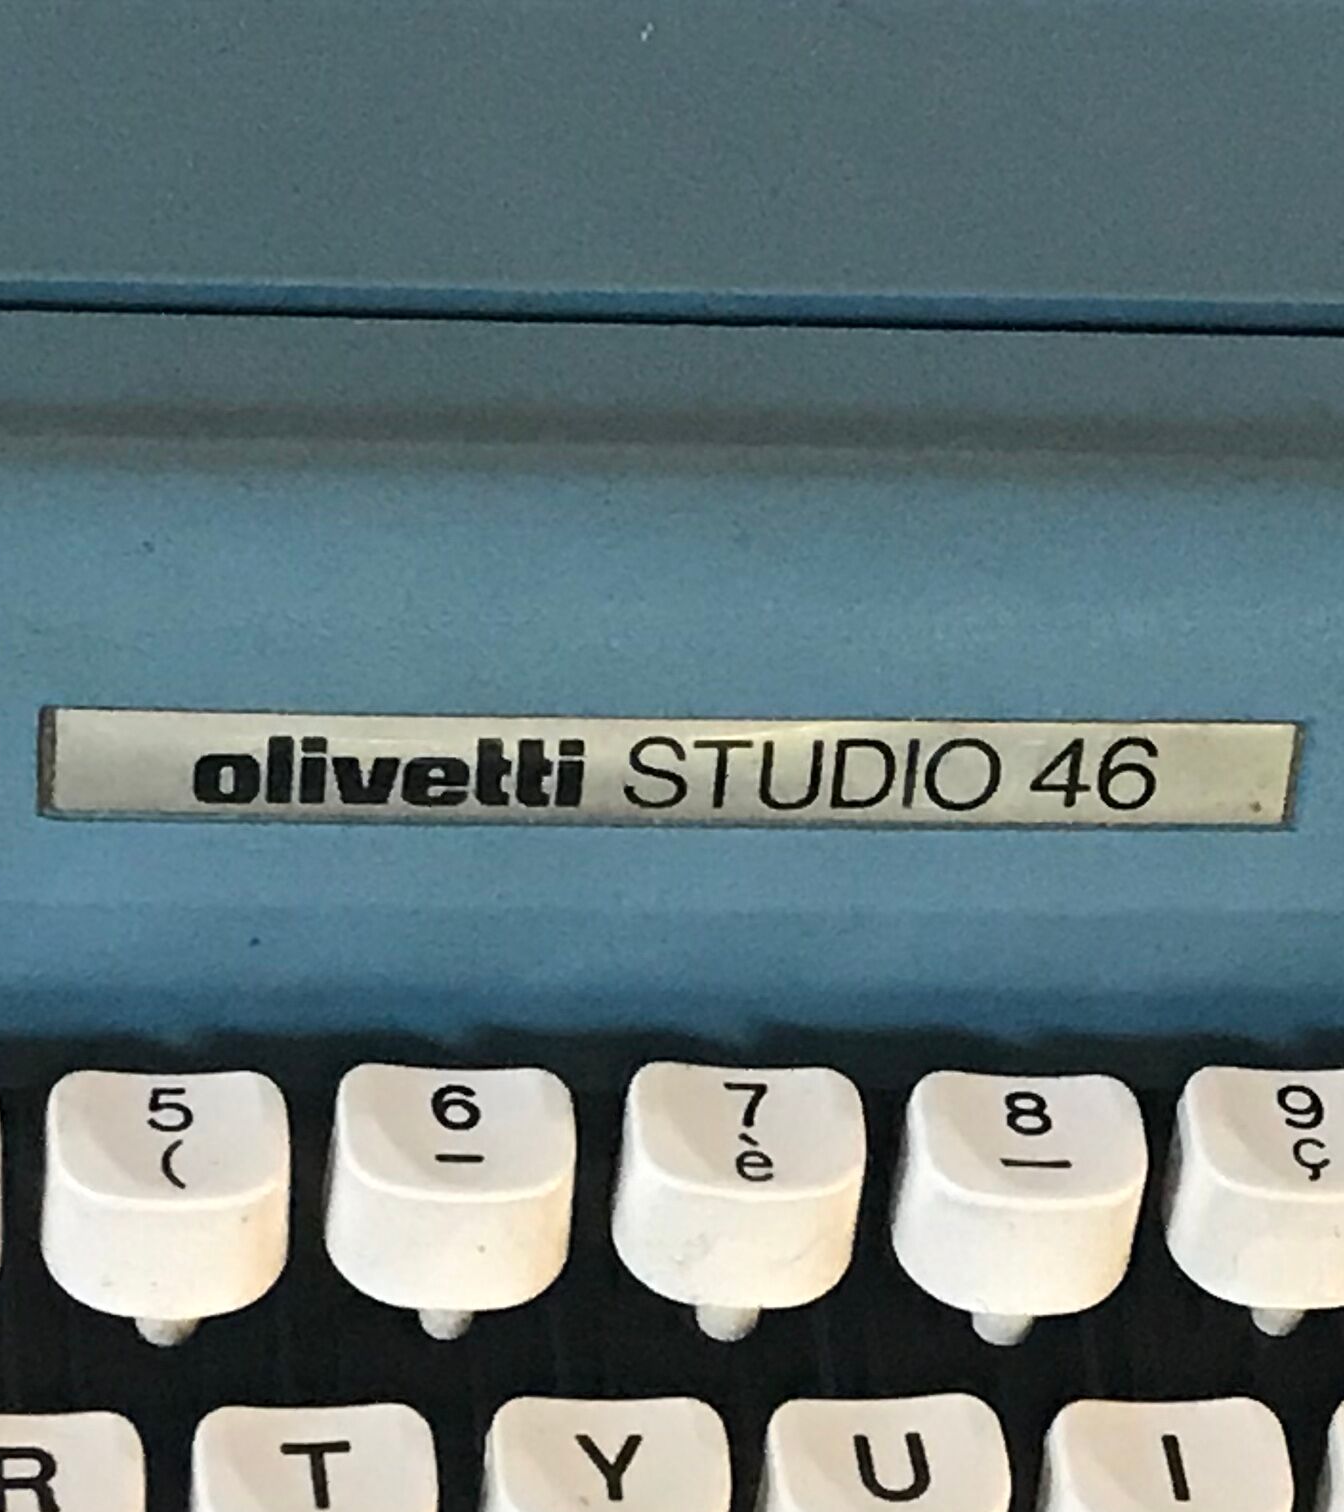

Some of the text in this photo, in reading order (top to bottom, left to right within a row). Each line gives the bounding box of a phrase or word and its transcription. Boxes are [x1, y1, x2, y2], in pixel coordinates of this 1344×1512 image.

[192, 735, 1159, 812] olivetti STUDIO 46
[146, 1086, 195, 1134] 5
[429, 1083, 482, 1132] 6
[722, 1081, 769, 1129] 7
[1003, 1090, 1054, 1137] 8
[1275, 1083, 1326, 1131] 9
[160, 1138, 187, 1191] (
[734, 1131, 775, 1183] è
[1291, 1137, 1332, 1183] ç
[279, 1439, 353, 1511] T
[574, 1433, 644, 1503] Y
[852, 1431, 932, 1504] U
[1160, 1433, 1192, 1503] I
